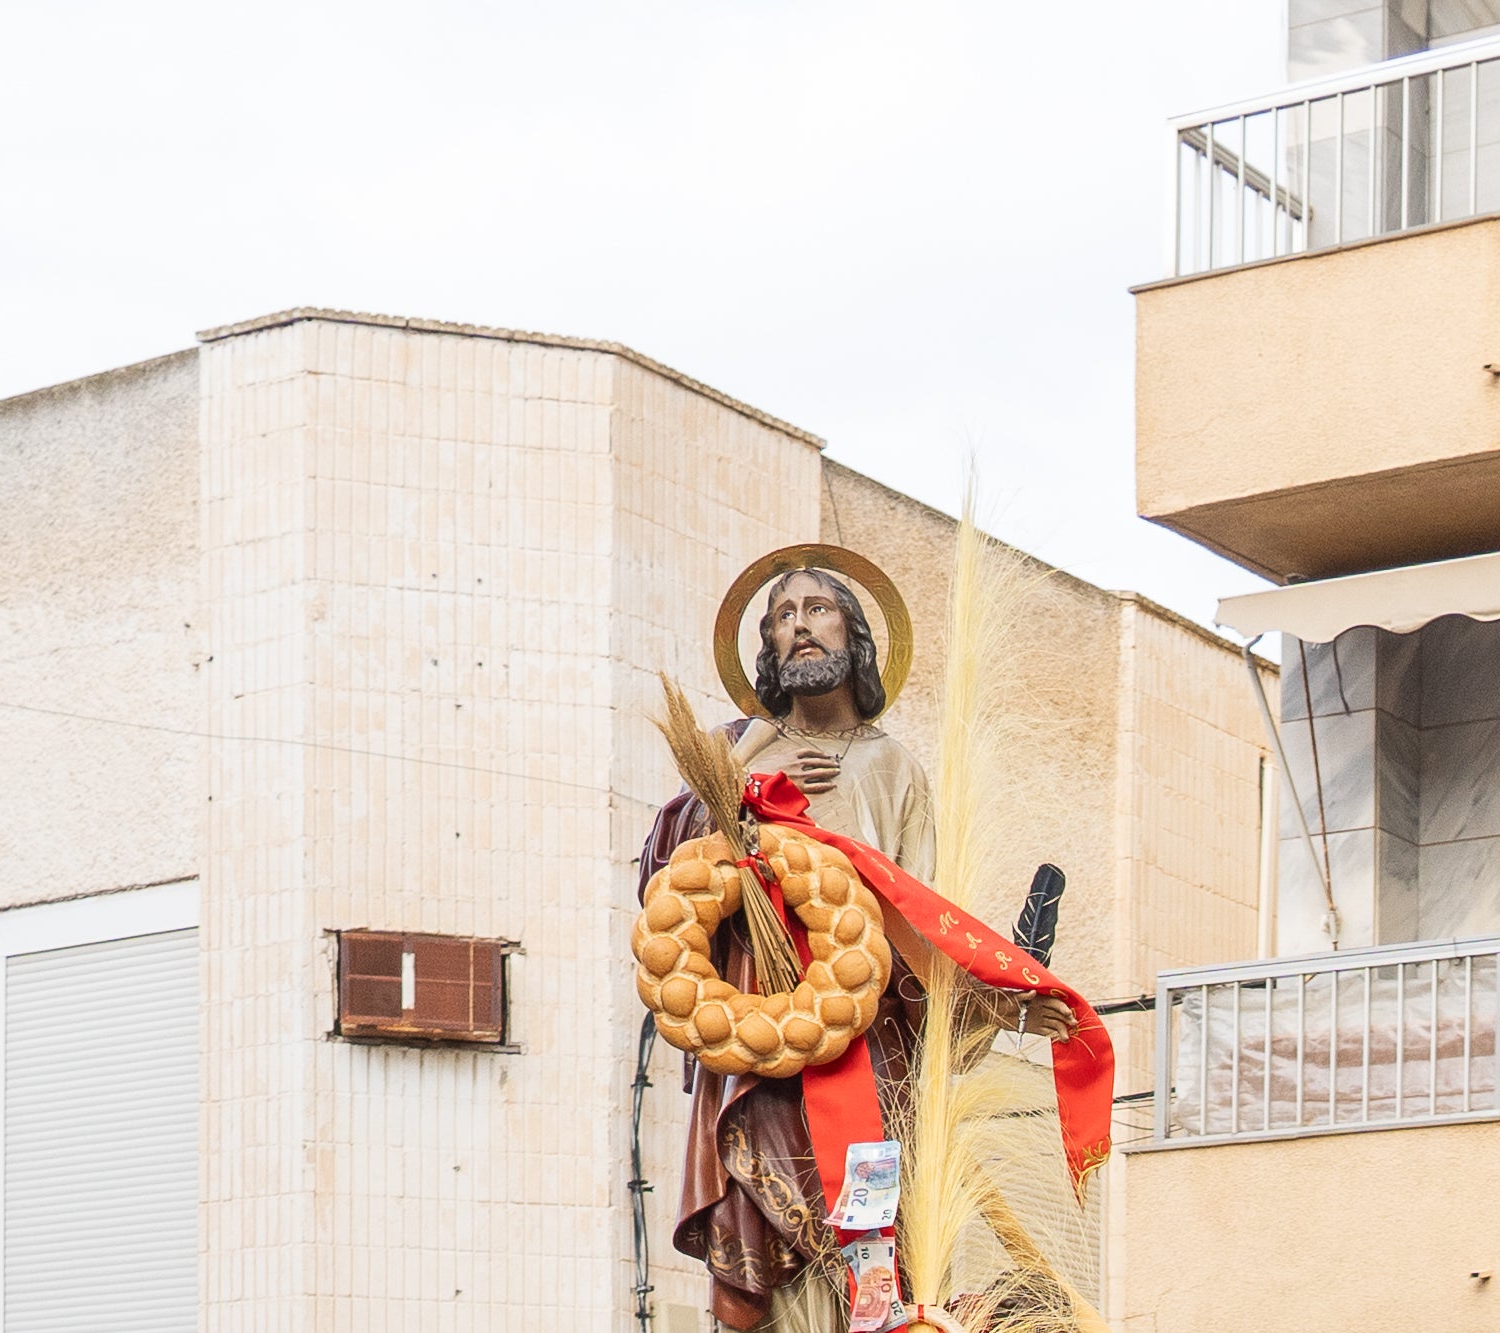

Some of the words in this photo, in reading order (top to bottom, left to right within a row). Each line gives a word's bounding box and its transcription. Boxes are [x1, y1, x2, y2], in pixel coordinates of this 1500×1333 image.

[851, 1188, 869, 1207] 20
[882, 1209, 892, 1220] 20
[861, 1247, 870, 1260] 10
[881, 1275, 893, 1293] 10
[891, 1301, 903, 1316] 20
